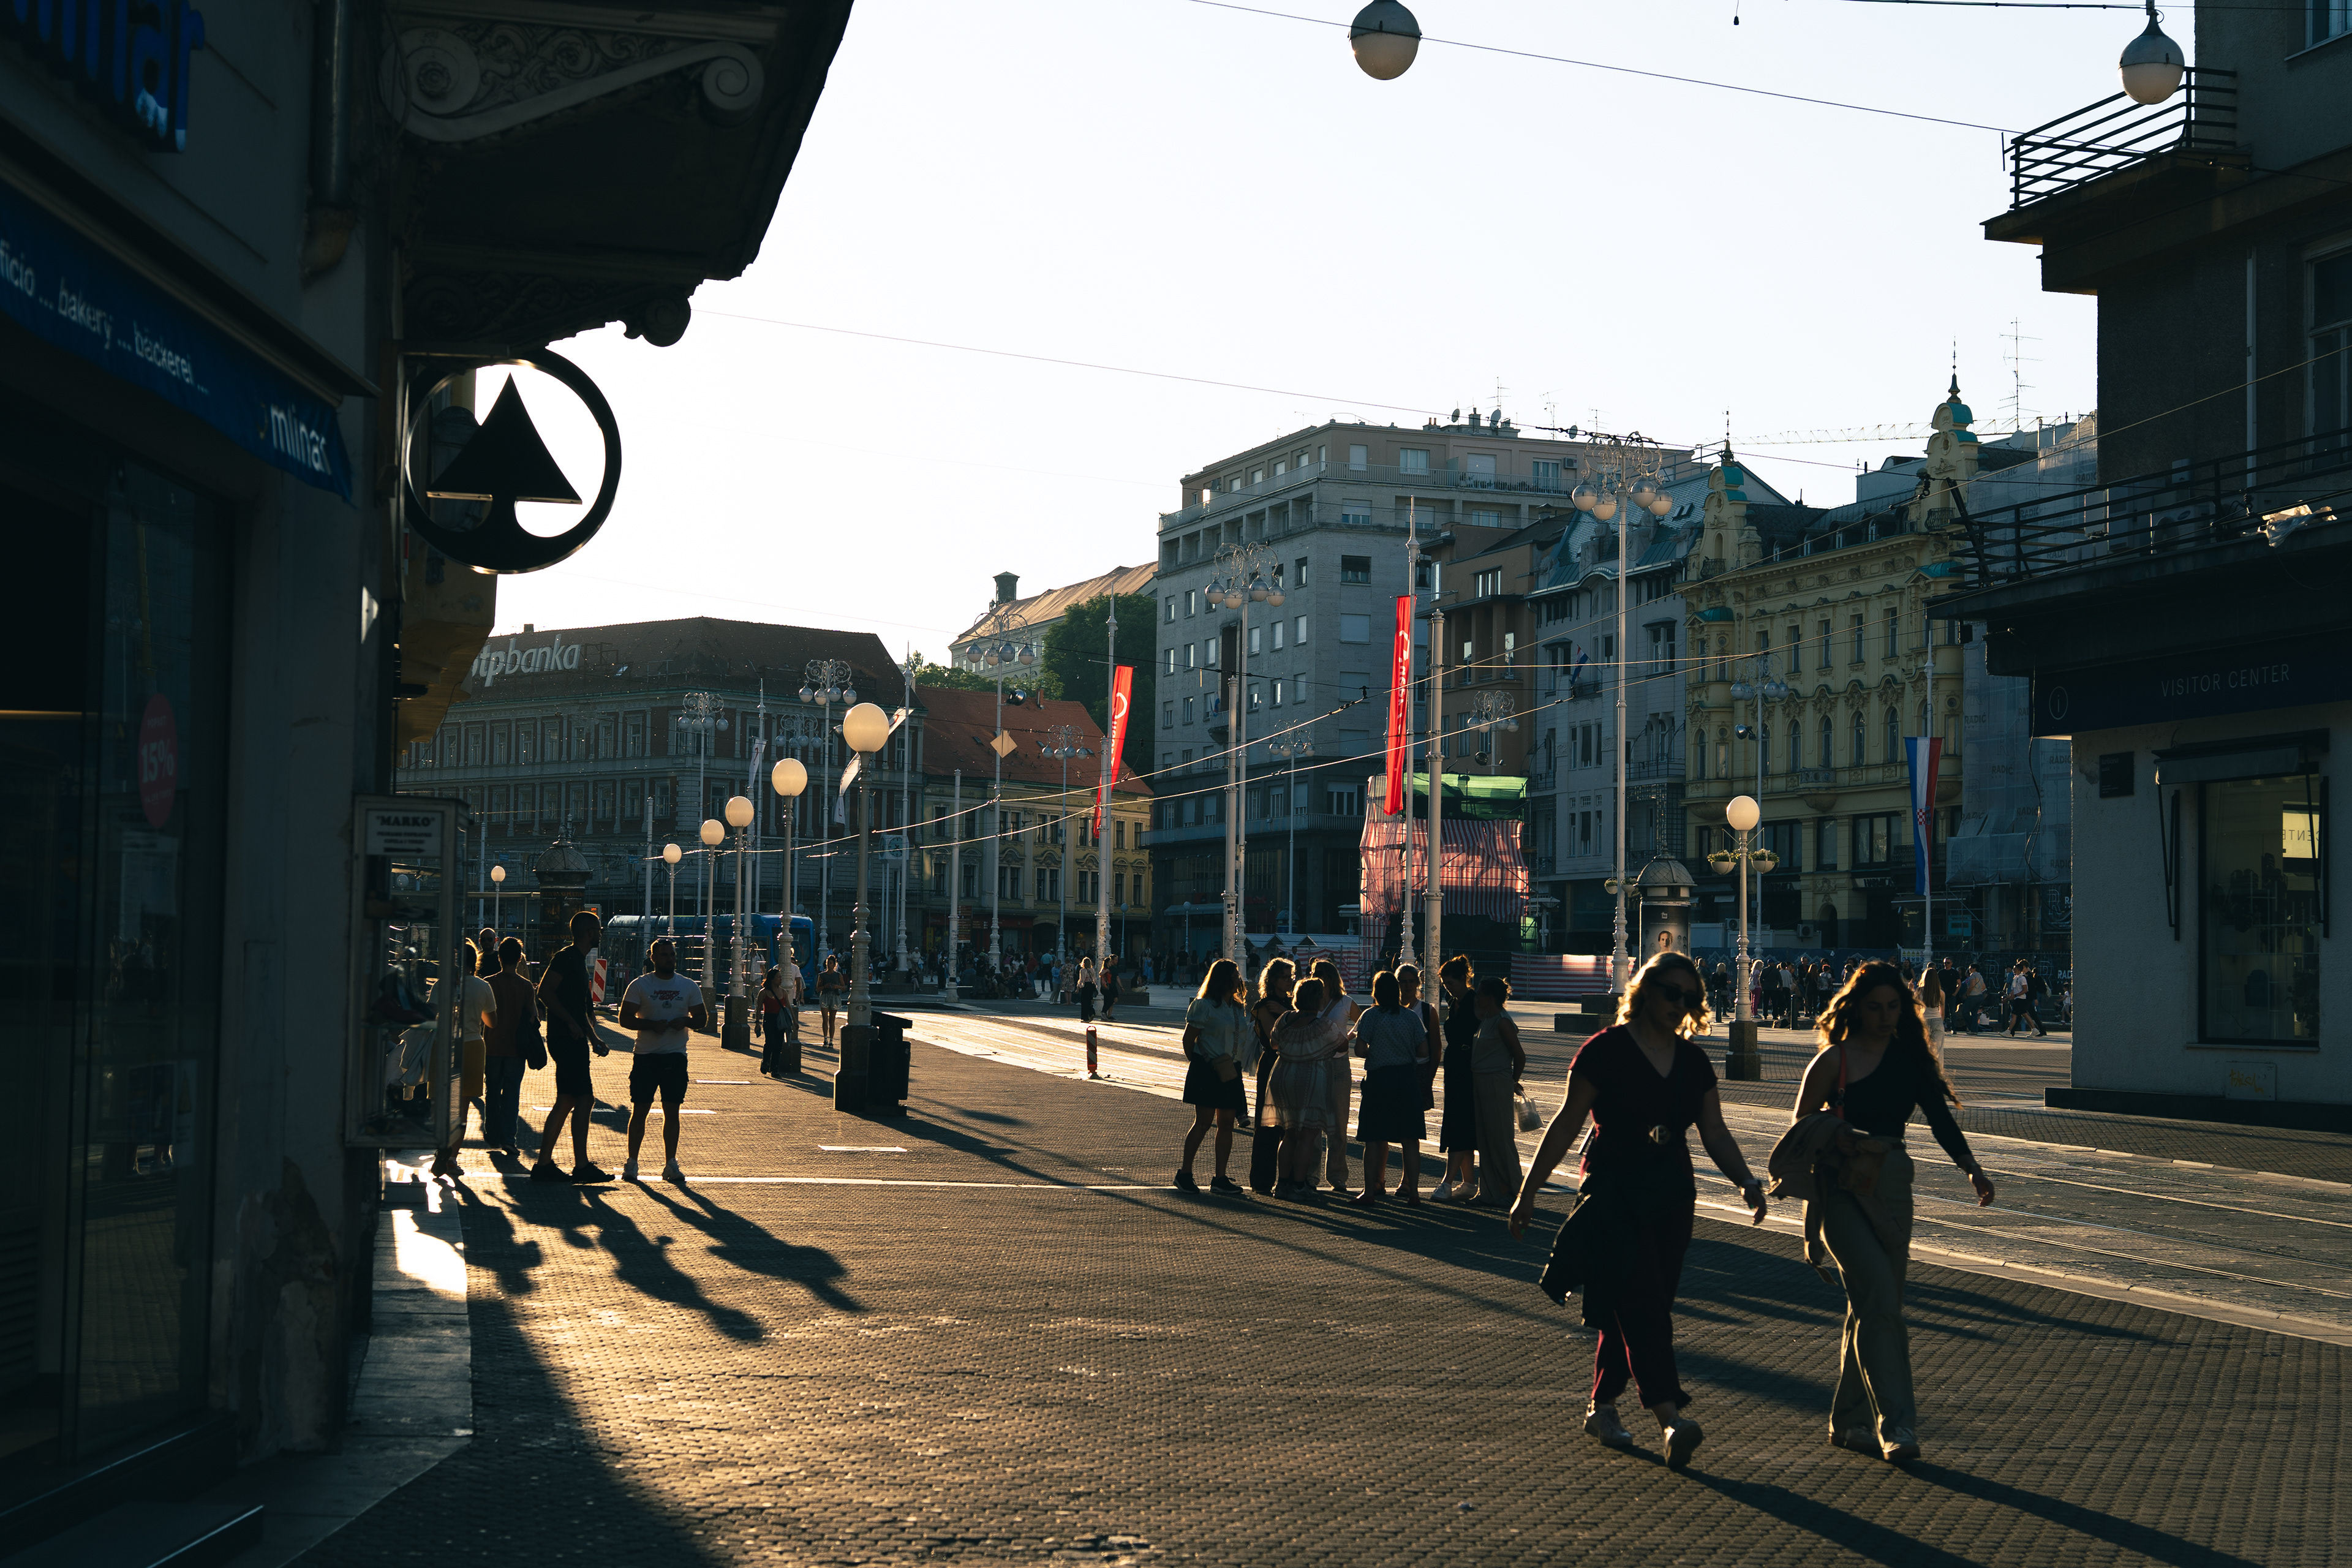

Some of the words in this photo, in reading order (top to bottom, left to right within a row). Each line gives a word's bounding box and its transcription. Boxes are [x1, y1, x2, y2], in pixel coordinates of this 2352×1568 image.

[58, 276, 114, 350] bakery
[133, 319, 195, 385] bäckerei
[271, 402, 332, 476] mlinar
[2162, 674, 2220, 697] VISITOR
[2228, 664, 2290, 688] CENTER
[1965, 712, 1986, 724] RADIĆ
[141, 738, 175, 783] 15%
[1992, 764, 2013, 775] RADIĆ
[375, 816, 435, 827] "MARKO"
